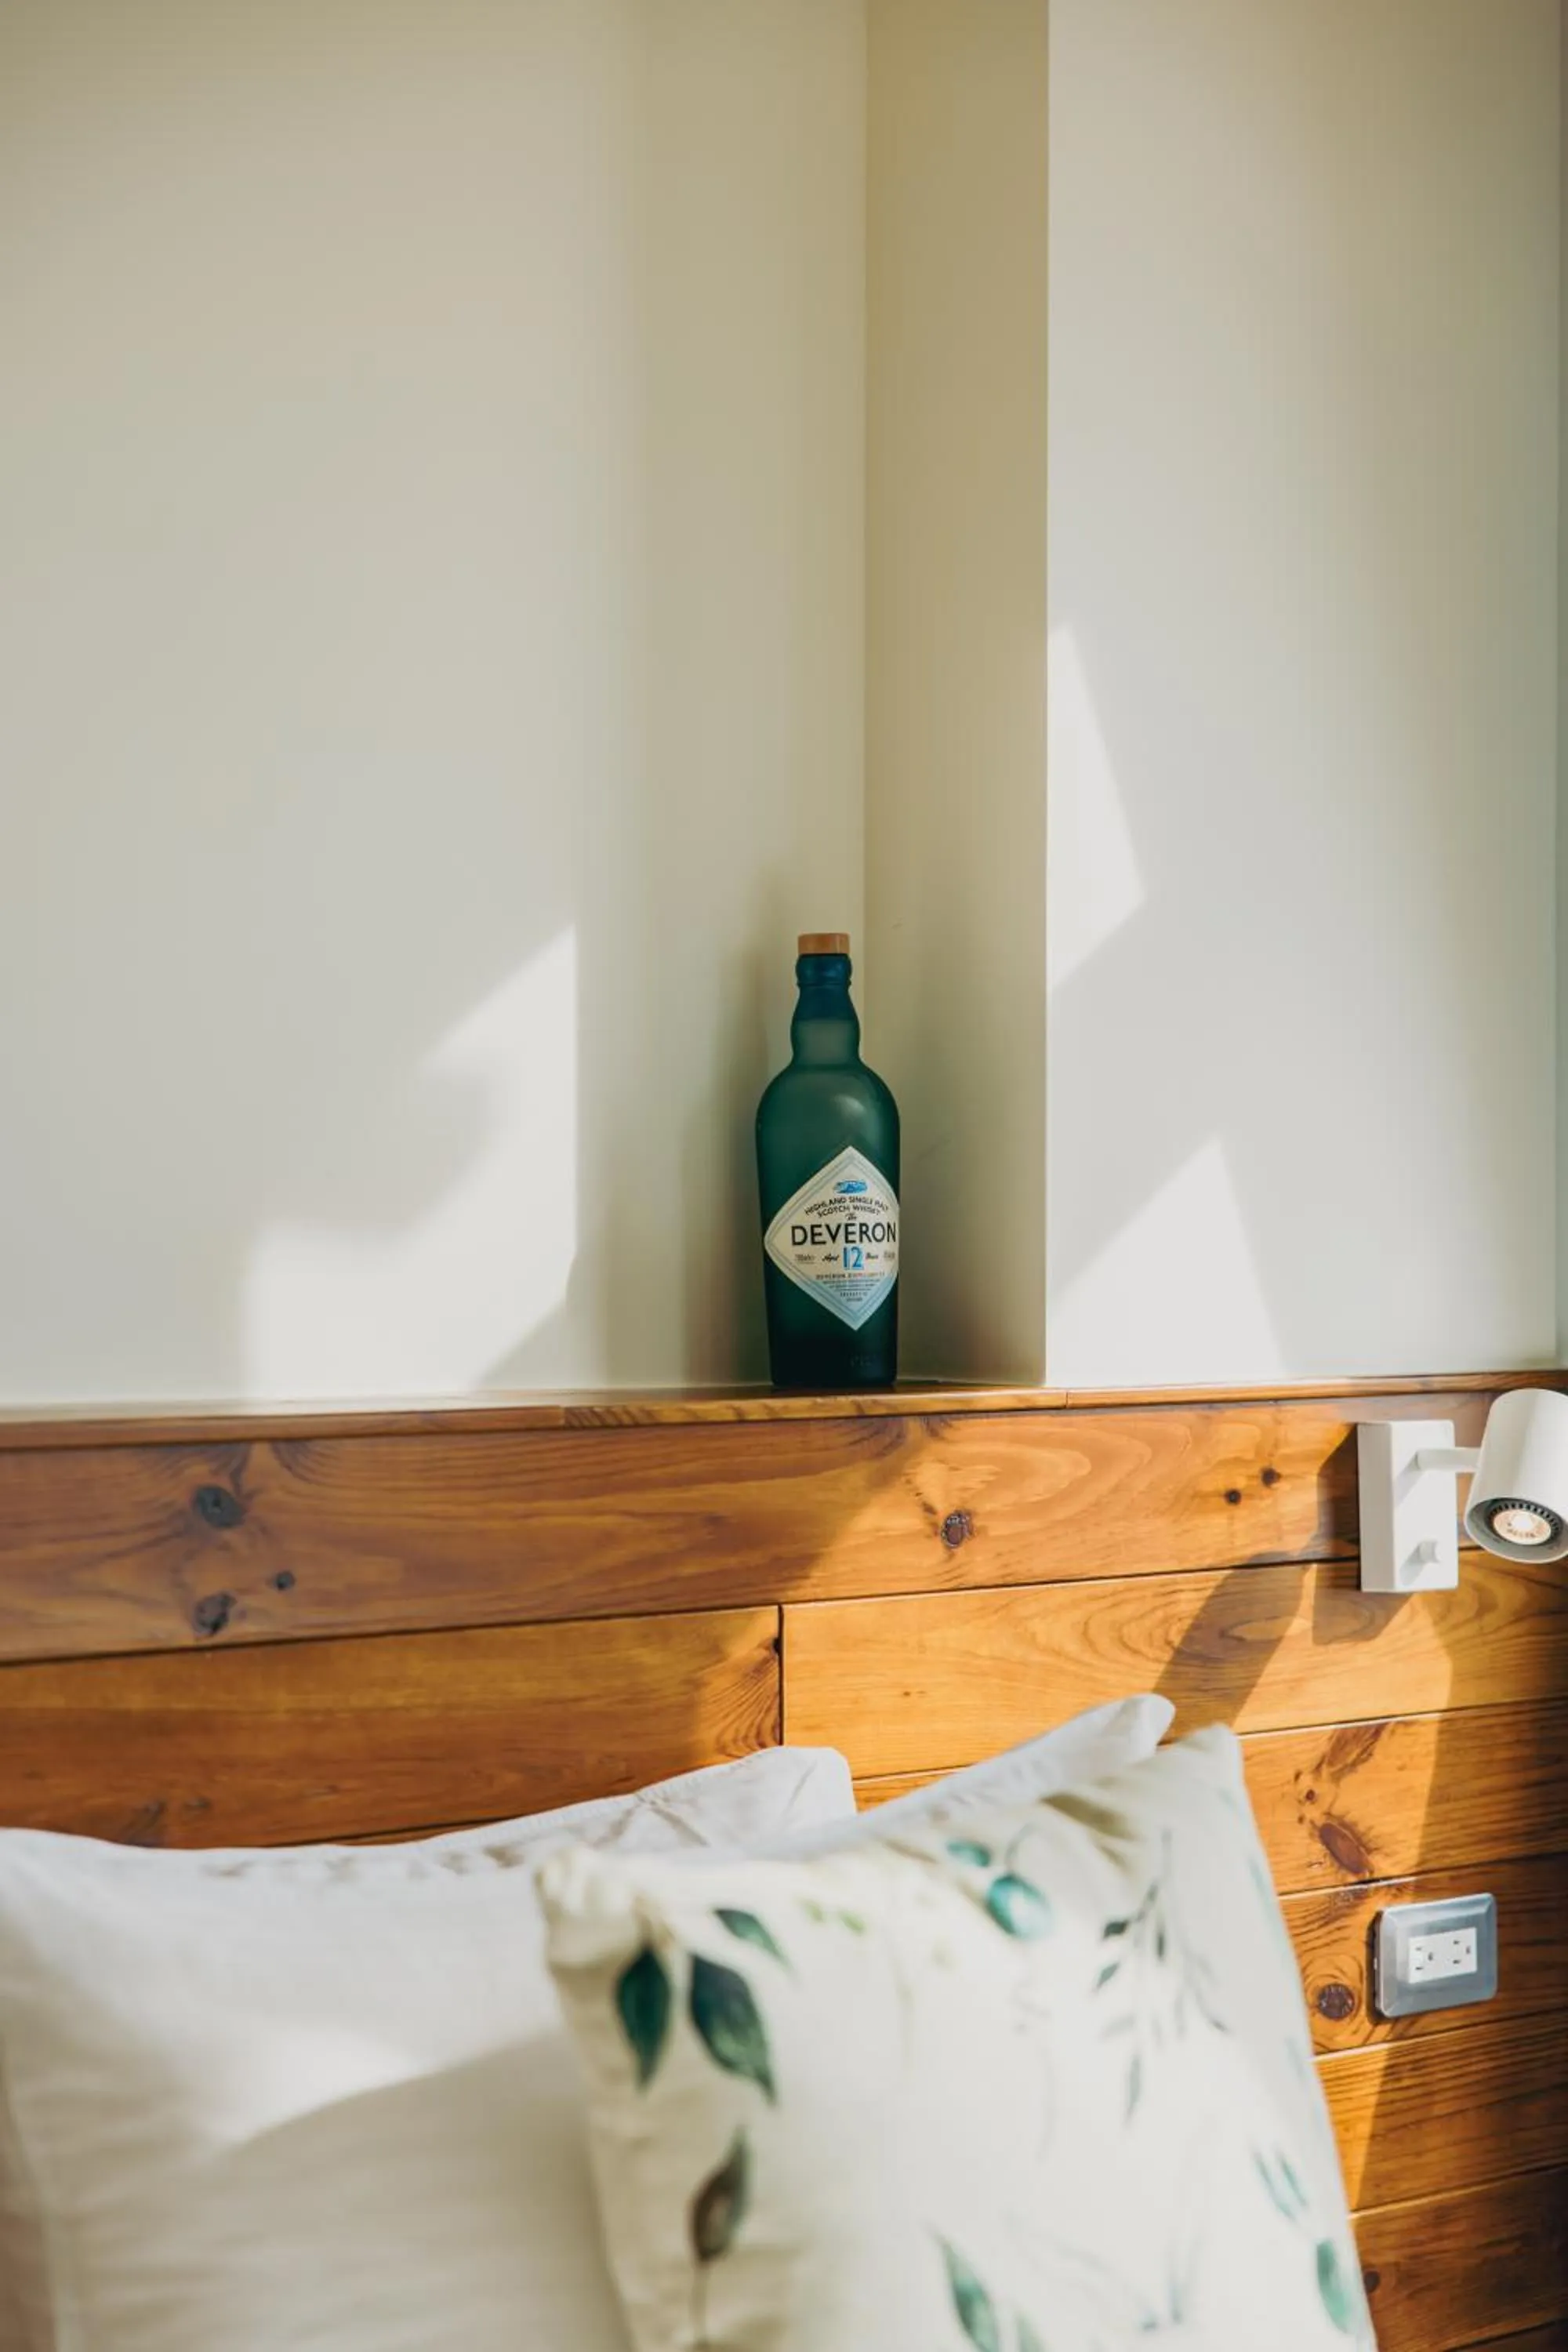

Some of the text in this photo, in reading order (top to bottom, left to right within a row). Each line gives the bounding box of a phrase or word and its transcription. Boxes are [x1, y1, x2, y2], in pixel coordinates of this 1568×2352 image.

[817, 1205, 851, 1218] SCOTCH
[791, 1221, 896, 1246] DEVERON
[843, 1246, 863, 1269] 12
